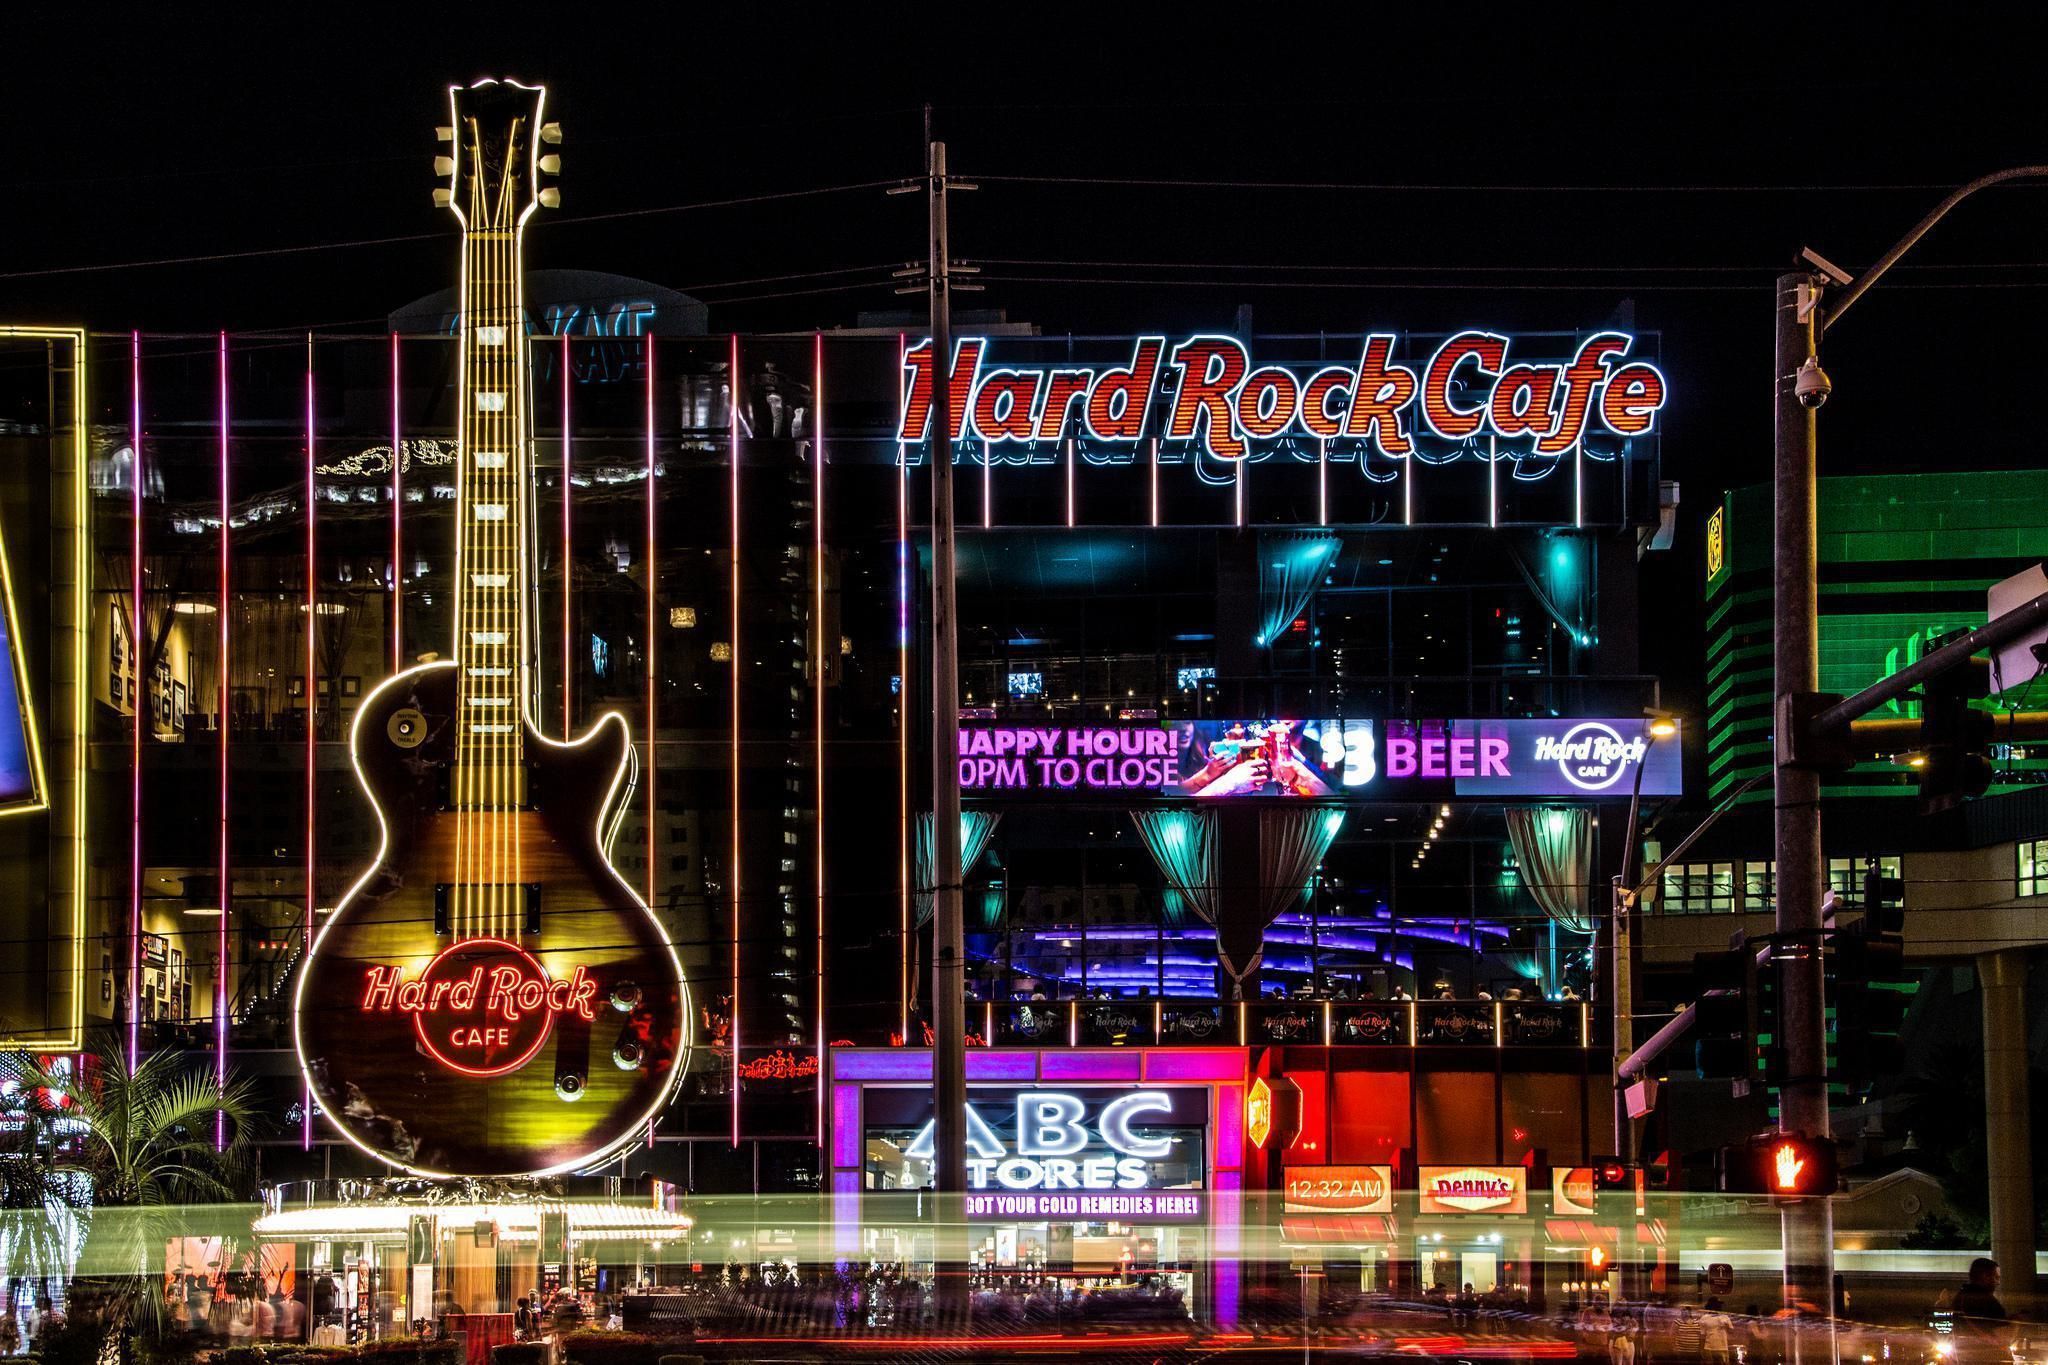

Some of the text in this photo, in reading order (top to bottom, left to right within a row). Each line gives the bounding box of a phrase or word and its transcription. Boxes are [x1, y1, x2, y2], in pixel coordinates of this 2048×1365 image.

[896, 331, 1667, 460] Hard Rock Cafe
[1067, 729, 1178, 757] HOUR!
[1534, 736, 1647, 765] Hard Rock
[1386, 738, 1512, 777] BEER
[1577, 766, 1608, 777] CAFE
[959, 758, 1179, 786] 0PM TO CLOSE
[363, 964, 597, 1021] Hard Rock
[451, 1027, 510, 1047] CAFE
[904, 1092, 1172, 1158] ABC
[929, 1158, 1148, 1190] TORES
[1289, 1180, 1382, 1198] 12:32 AM
[1437, 1178, 1509, 1199] Denny's
[966, 1196, 1198, 1214] GOT YOUR COLD REMEDIES HERE!
